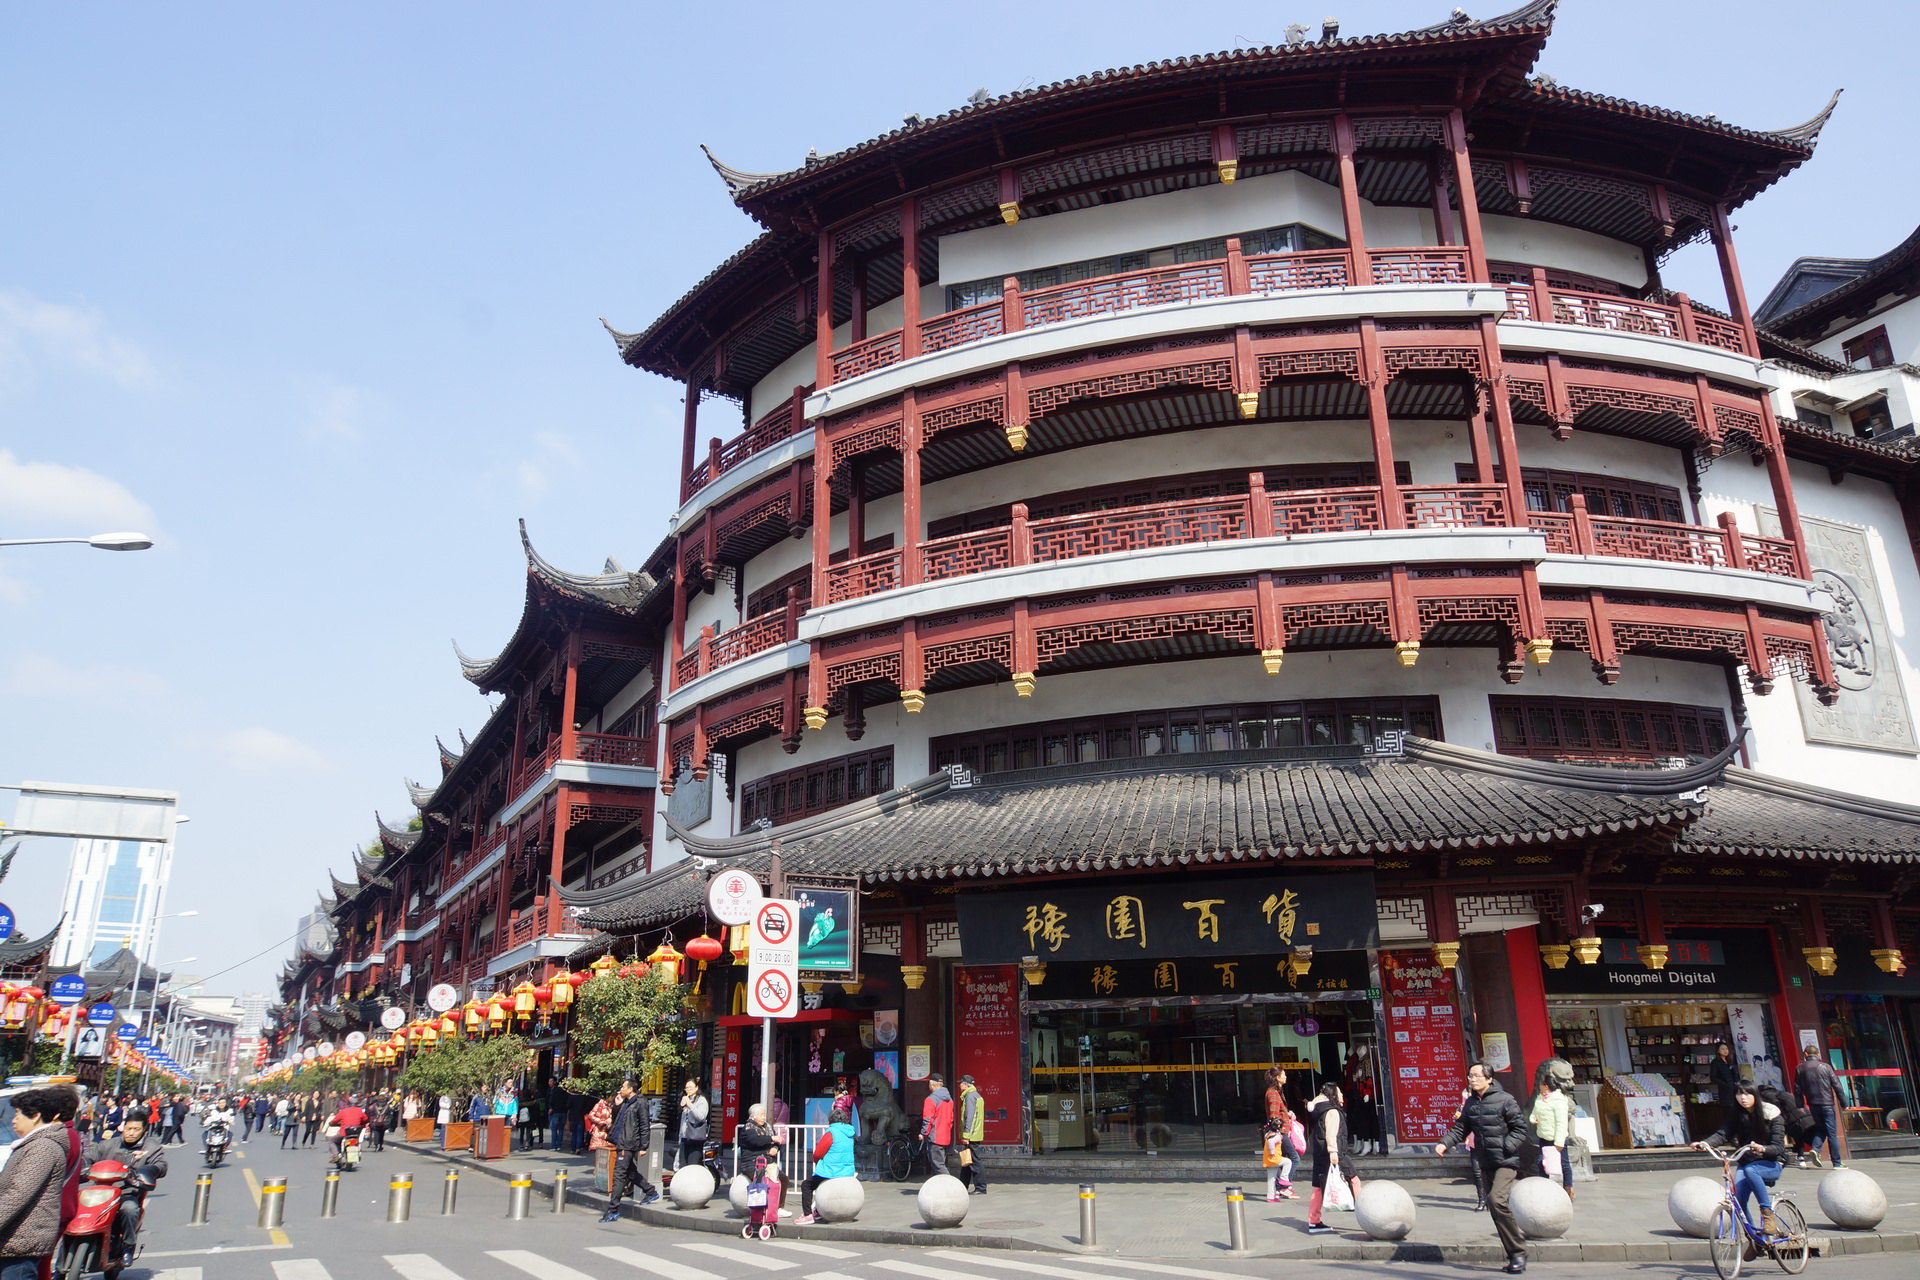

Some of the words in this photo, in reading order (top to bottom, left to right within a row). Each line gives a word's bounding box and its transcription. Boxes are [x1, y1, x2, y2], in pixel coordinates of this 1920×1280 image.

[1022, 888, 1301, 951] 豫園百貨
[1608, 971, 1663, 986] Hongmei
[1668, 971, 1716, 986] Digital
[1367, 988, 1380, 996] 159
